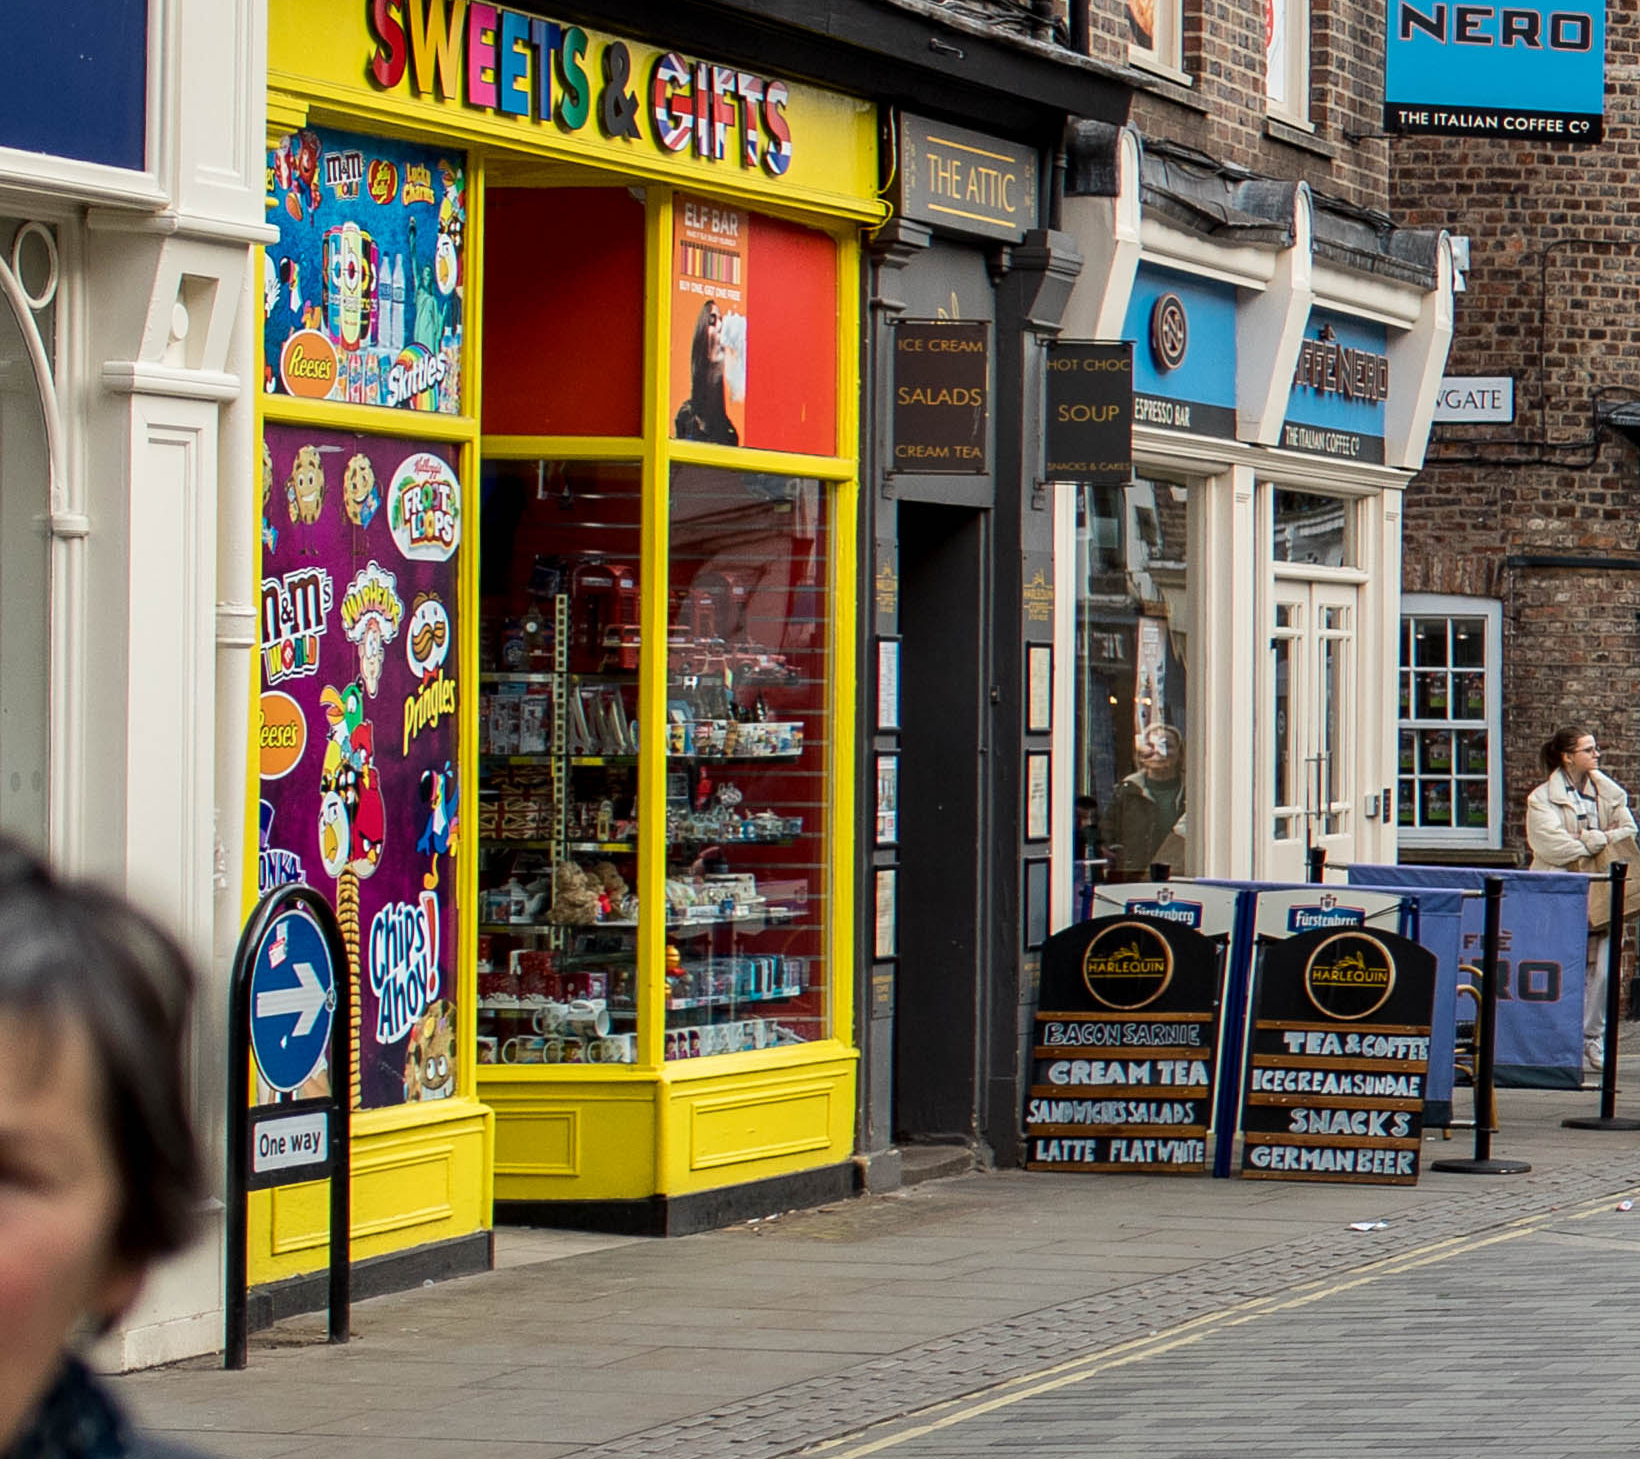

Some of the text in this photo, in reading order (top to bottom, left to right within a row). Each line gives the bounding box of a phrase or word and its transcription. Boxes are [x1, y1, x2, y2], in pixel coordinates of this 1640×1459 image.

[1399, 0, 1592, 52] NERO
[604, 42, 642, 139] &
[654, 51, 792, 176] GIFTS
[1399, 111, 1428, 125] THE
[1434, 113, 1498, 129] ITALIAN
[1504, 117, 1563, 132] COFFEE
[926, 153, 961, 200] THE
[966, 165, 1016, 213] ATTIC
[684, 202, 738, 236] ELF BAR
[898, 339, 983, 353] ICE CREAM
[387, 350, 448, 408] Skittles
[1047, 358, 1131, 373] HOT CHOC
[1336, 344, 1389, 401] NERO
[898, 387, 982, 407] SALADS
[1058, 404, 1119, 423] SOUP
[1135, 397, 1191, 428] ESPRESSO BAR
[895, 444, 982, 460] CREAM TEA
[1285, 426, 1298, 446] THE
[1299, 427, 1324, 452] ITALIAN
[1326, 432, 1350, 456] COFFEE
[403, 485, 448, 519] FROOT
[409, 513, 454, 544] LOOPS
[343, 579, 400, 627] WARHEADS
[268, 635, 319, 677] WORLD
[403, 677, 456, 757] Pringles
[371, 902, 425, 998] Chips
[1088, 961, 1164, 974] HARLEQUIN
[1312, 969, 1388, 983] HARLEQUIN
[1044, 1022, 1200, 1045] BACON SARNIE
[1283, 1031, 1430, 1060] TEA & COFFEE
[1048, 1060, 1209, 1085] CREAM TEA
[1355, 1073, 1420, 1097] SUNDAE
[1128, 1102, 1194, 1124] SALADS
[1289, 1109, 1411, 1136] SNACKS
[259, 1128, 322, 1158] One way
[1036, 1140, 1204, 1164] LATTE FLAT WHITE
[1251, 1146, 1414, 1175] GERMAN BEER
